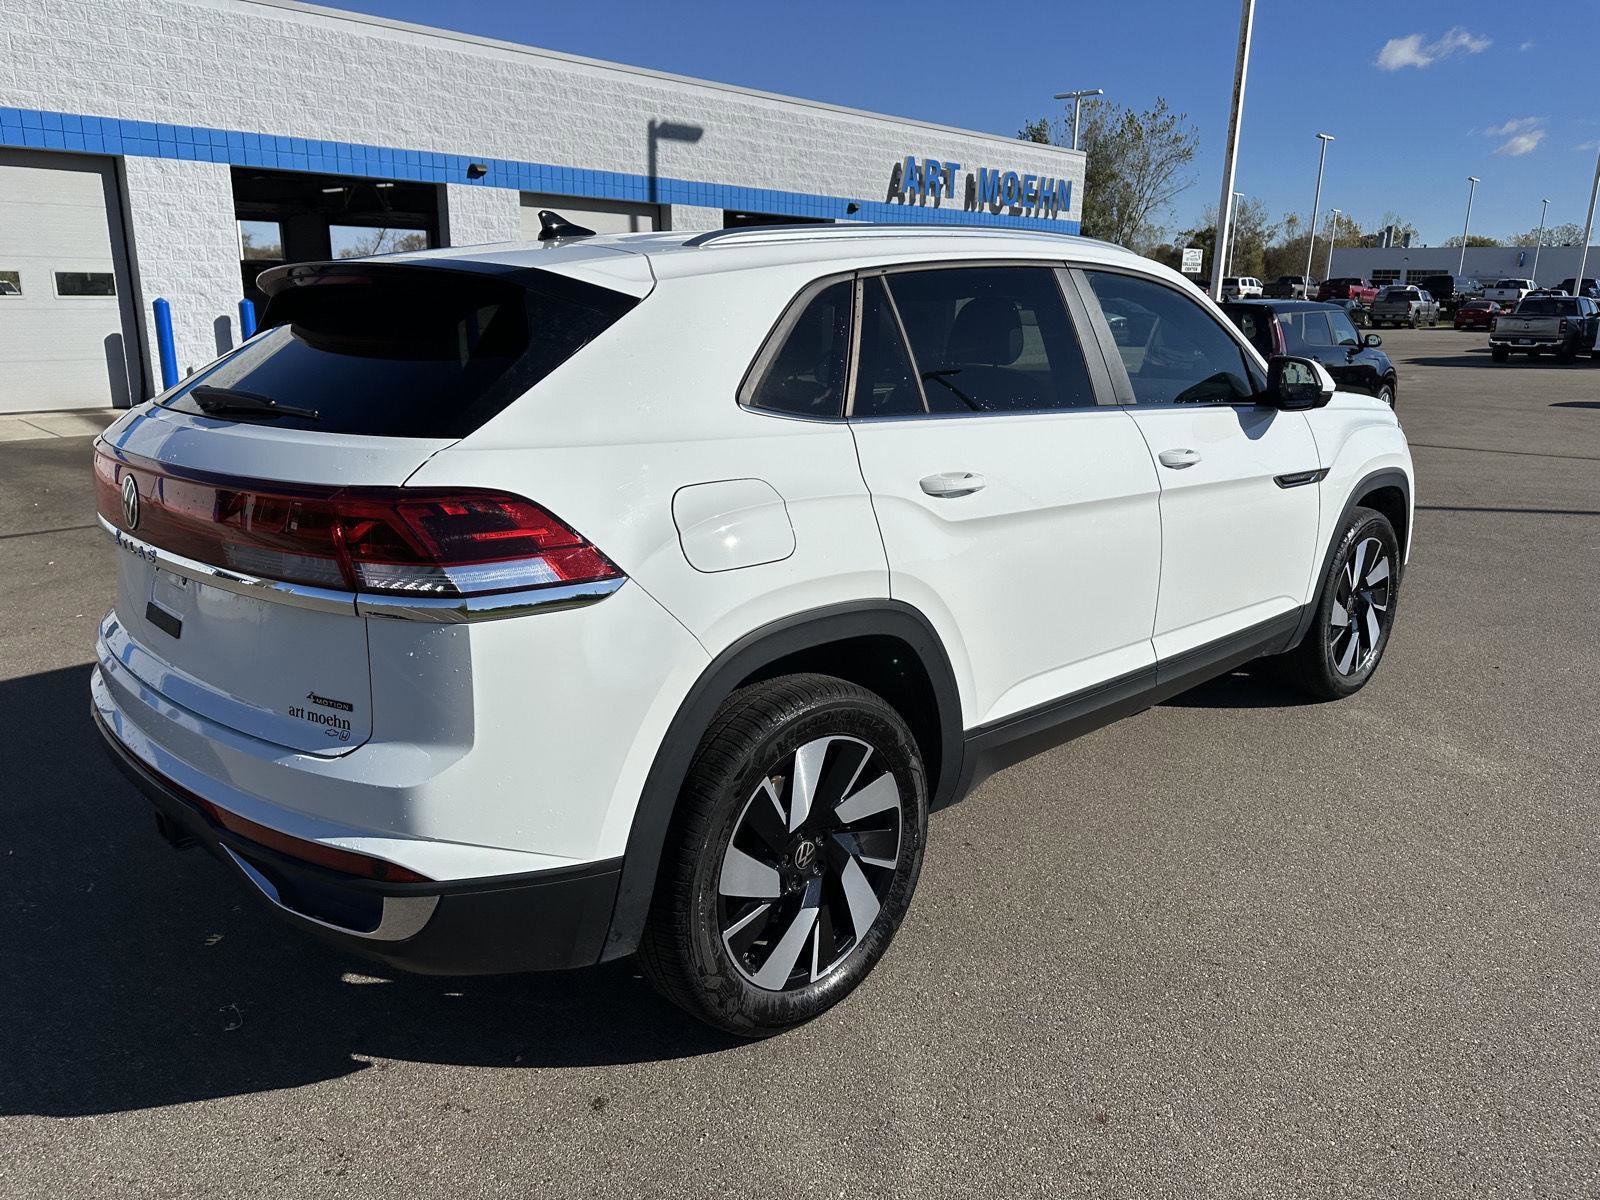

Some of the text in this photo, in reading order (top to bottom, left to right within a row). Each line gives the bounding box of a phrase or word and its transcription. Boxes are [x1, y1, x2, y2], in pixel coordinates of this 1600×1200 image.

[901, 155, 1072, 212] ART MOEHN
[288, 705, 351, 730] art moehn
